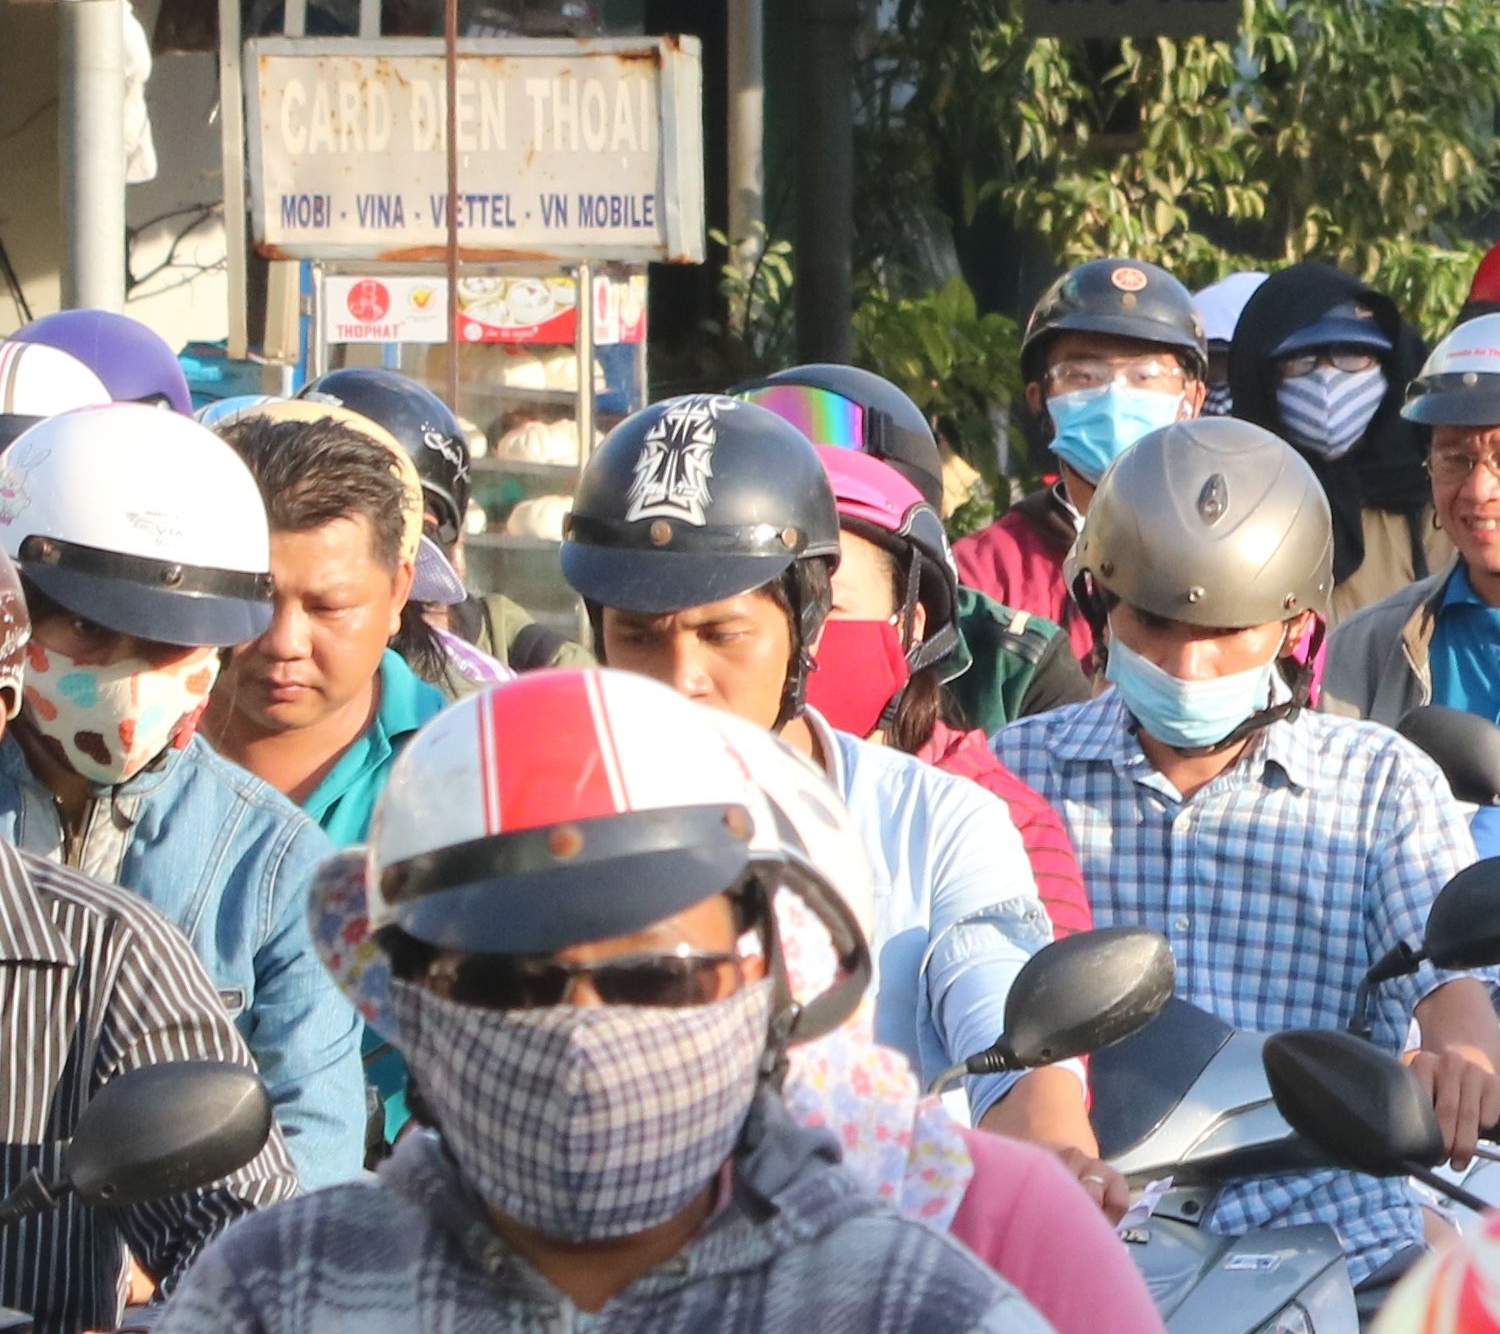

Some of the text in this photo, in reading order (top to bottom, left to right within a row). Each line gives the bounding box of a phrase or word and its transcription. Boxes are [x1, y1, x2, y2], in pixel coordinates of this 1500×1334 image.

[280, 77, 393, 156] CARD
[526, 77, 653, 169] THOẠI
[280, 194, 656, 230] MOBI VINA VIETTEL VN MOBILE
